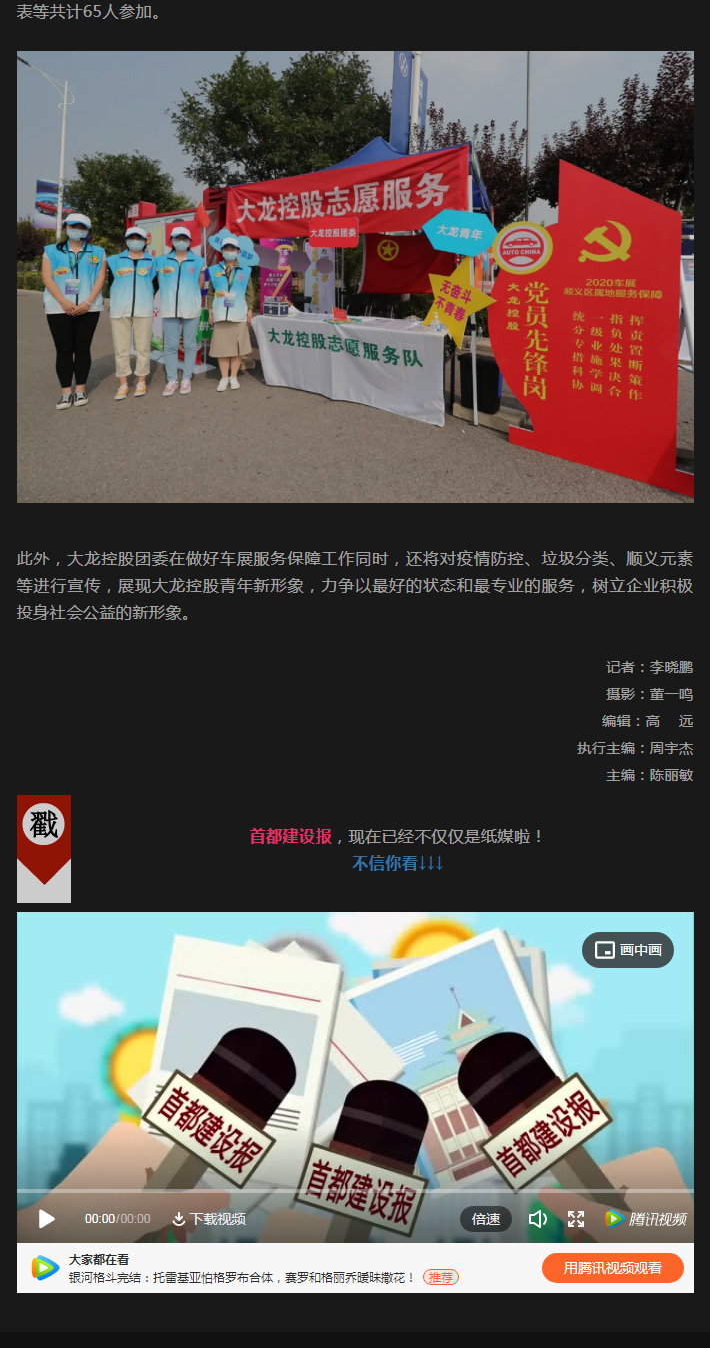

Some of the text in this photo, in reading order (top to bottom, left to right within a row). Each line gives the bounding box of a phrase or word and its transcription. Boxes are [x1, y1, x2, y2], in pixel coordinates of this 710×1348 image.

[17, 4, 159, 20] 表等共计65人参加。
[236, 172, 450, 223] 大龙控股志愿服务
[310, 228, 357, 238] 大龙控股团委
[436, 224, 484, 241] 大龙青年
[585, 278, 637, 288] 2020车展
[439, 279, 472, 305] 无奋斗
[563, 287, 663, 300] 顺义区属地服务保障
[435, 295, 467, 323] 不青春
[506, 282, 521, 331] 大龙控股
[572, 311, 644, 327] 统一指挥
[522, 281, 550, 401] 党员先锋岗
[573, 325, 644, 342] 分级负责
[267, 327, 424, 368] 大龙控股志愿服务队
[574, 338, 643, 356] 专业处置
[572, 351, 644, 372] 措施果断
[572, 365, 642, 386] 科学决策
[572, 379, 643, 400] 协调合作
[17, 550, 694, 567] 此外，大龙控股团委在做好车展服务保障工作同时，还将对疫情防控、垃圾分类、顺义元素
[17, 577, 694, 594] 等进行宣传，展现大龙控股青年新形象，力争以最好的状态和最专业的服务，树立企业积极
[17, 604, 189, 621] 投身社会公益的新形象。
[606, 660, 694, 675] 记者：李晓鹏
[606, 688, 694, 702] 摄影：董一鸣
[602, 715, 694, 728] 编辑：高 远
[577, 742, 694, 756] 执行主编：周宇杰
[606, 769, 694, 782] 主编：陈丽敏
[29, 809, 59, 839] 戳
[250, 828, 541, 845] 首都建设报，现在已经不仅仅是纸媒啦！
[620, 943, 662, 957] 画中画
[158, 1086, 263, 1174] 首都建设报
[495, 1089, 602, 1178] 首都建设报
[304, 1158, 418, 1228] 首都建设报
[85, 1212, 151, 1226] 00:00/00:00
[189, 1212, 247, 1227] 下载视频
[471, 1212, 501, 1227] 倍速
[628, 1211, 688, 1227] 腾讯视频
[69, 1254, 130, 1266] 大家都在看
[563, 1260, 663, 1276] 用腾讯视频观看
[429, 1272, 454, 1284] 推荐
